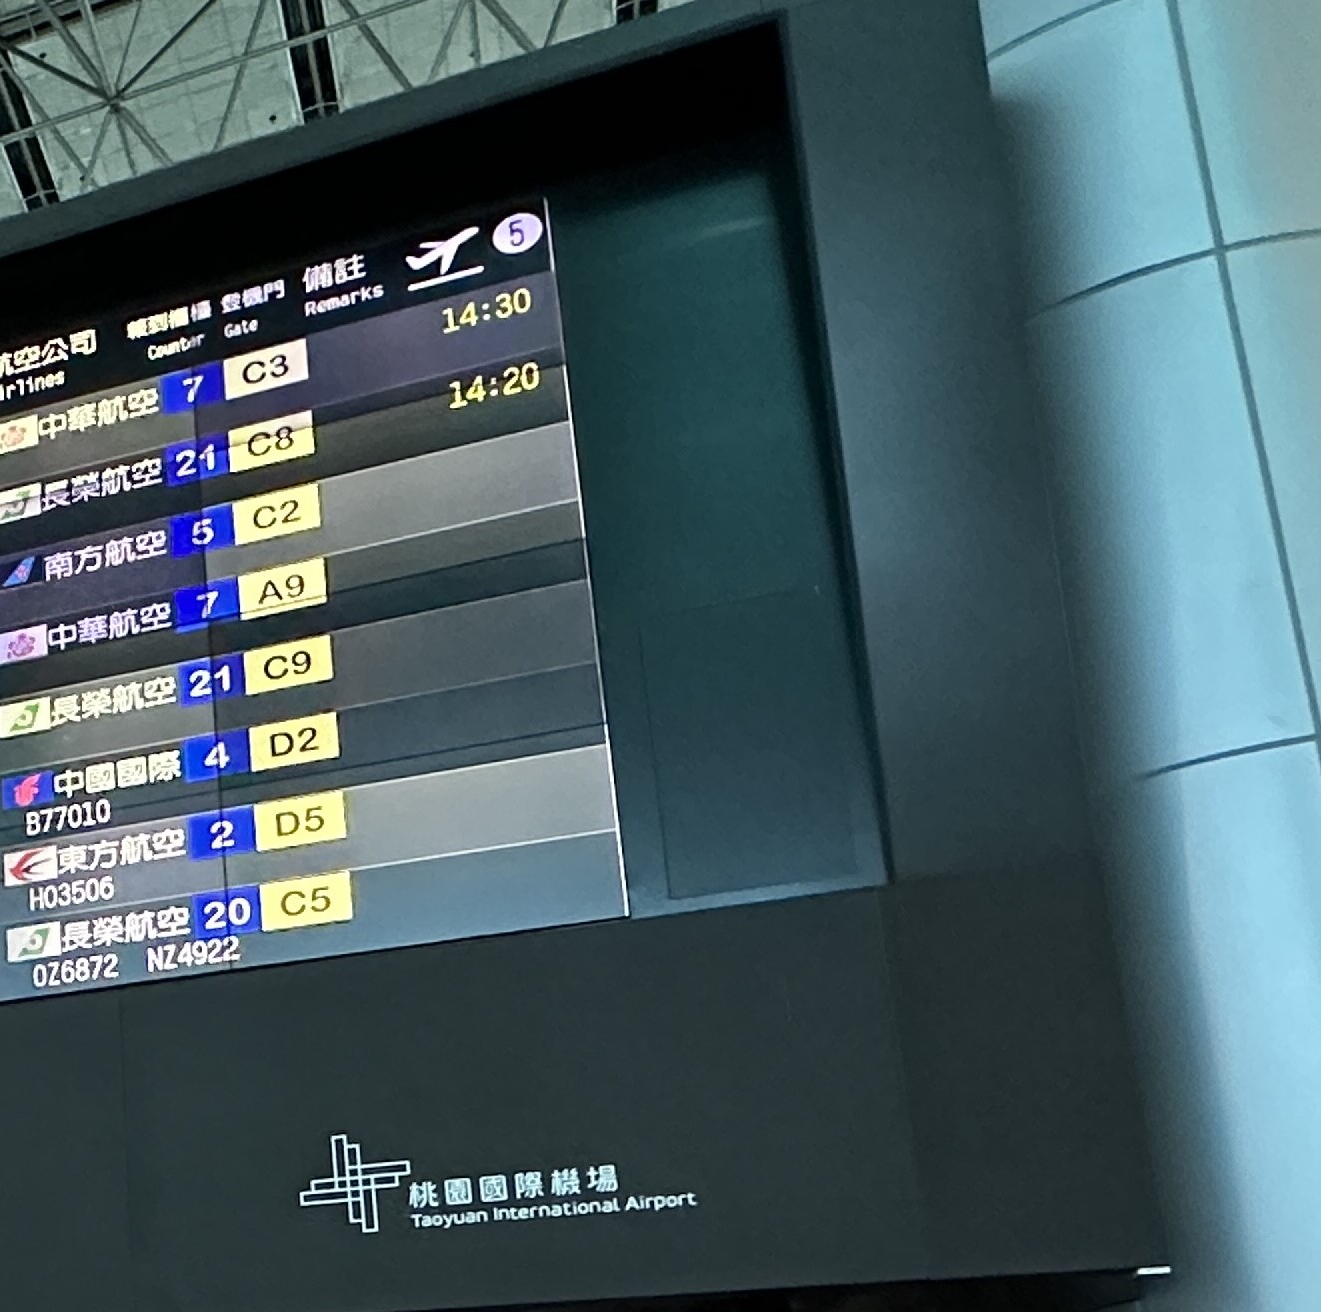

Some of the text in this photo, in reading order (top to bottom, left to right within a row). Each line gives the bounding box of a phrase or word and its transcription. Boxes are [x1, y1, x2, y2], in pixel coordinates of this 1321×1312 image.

[302, 254, 365, 291] 備註
[224, 318, 257, 338] Gate
[305, 284, 383, 317] Remarks
[38, 289, 532, 441] 中華航空 C3 14:30
[41, 362, 540, 511] 長榮航空 21 C8 14:20
[44, 500, 302, 581] 南方航空 5 C2
[48, 574, 305, 651] 中華航空 A9
[50, 650, 312, 726] 長榮航空 21 C9
[54, 726, 319, 799] 中國國際 4 D2
[26, 798, 111, 837] B77010
[58, 805, 326, 875] 東方航空 2 D5
[61, 886, 332, 953] 長榮航空 20 C5
[146, 935, 241, 974] NZ4922
[409, 1164, 619, 1209] 桃園國際機場
[410, 1191, 696, 1230] Taoyuan International Airport
